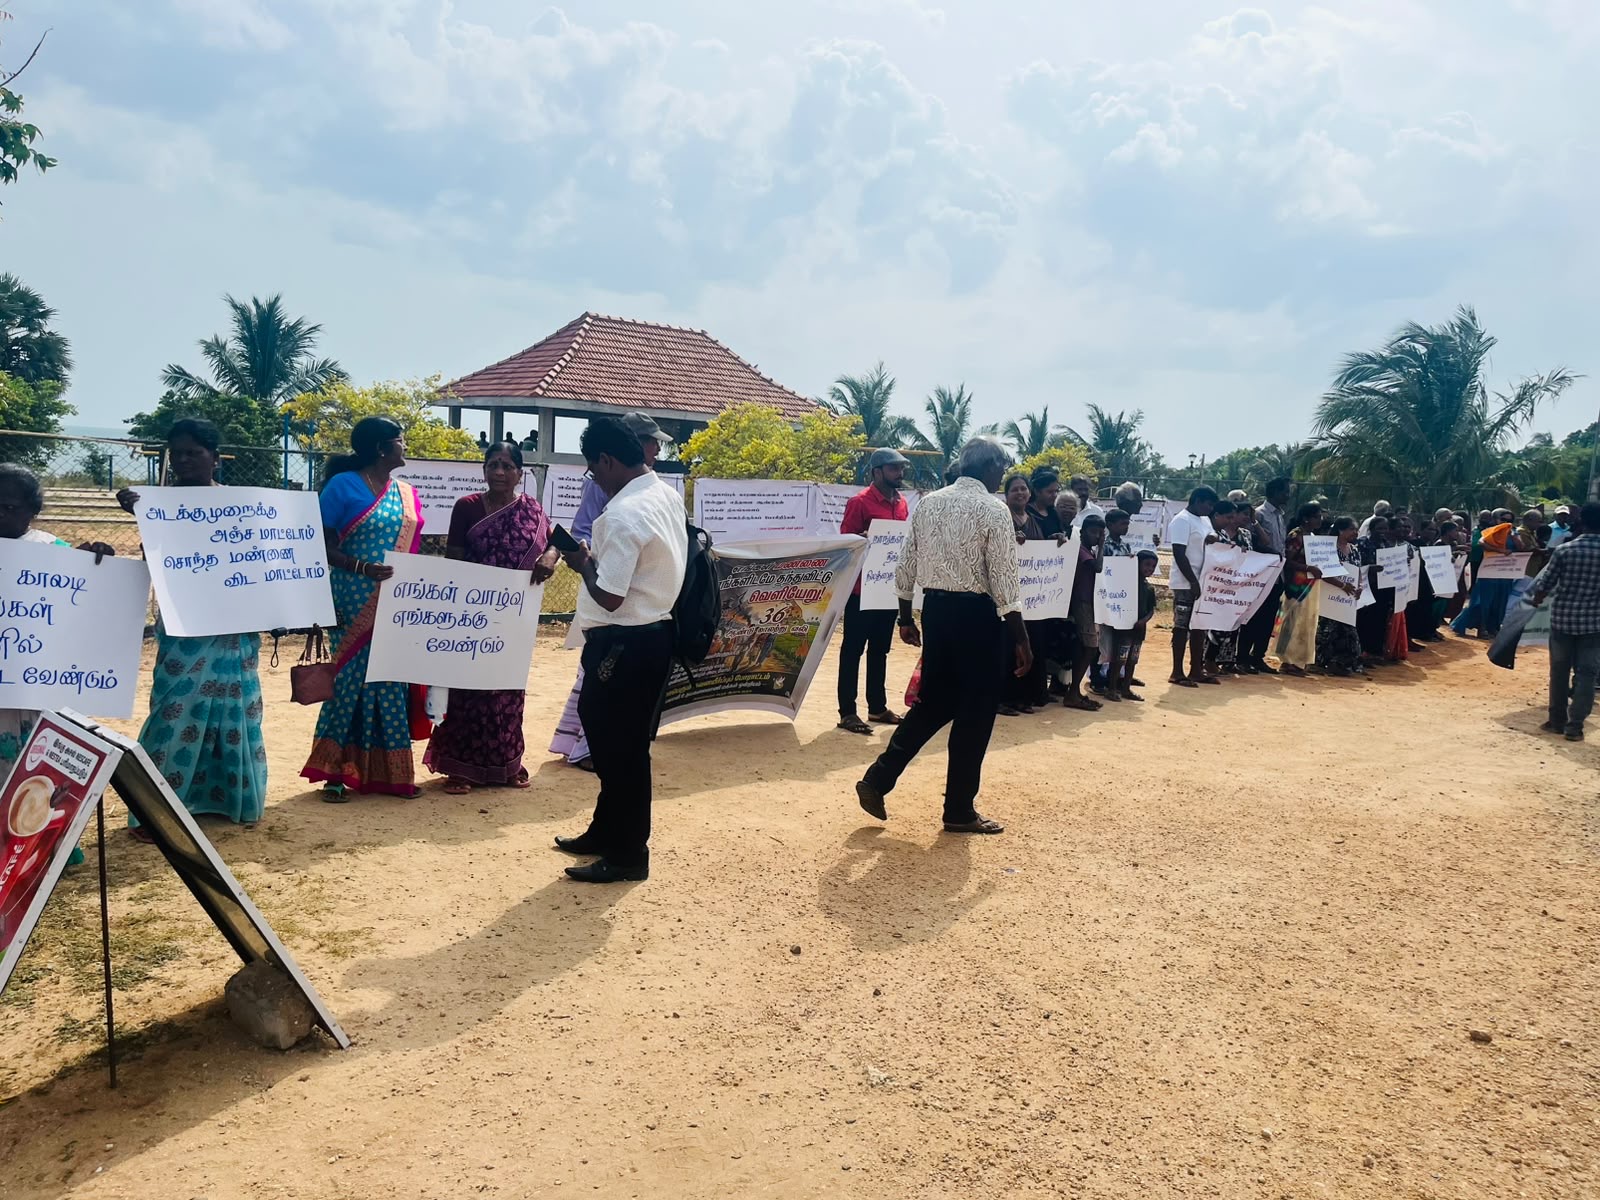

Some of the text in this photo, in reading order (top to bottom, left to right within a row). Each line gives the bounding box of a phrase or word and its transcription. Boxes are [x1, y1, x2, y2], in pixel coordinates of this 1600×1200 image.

[145, 501, 277, 523] அடக்குமுறைக்கு
[210, 524, 315, 544] அஞ்ச மாட்டோம்
[163, 551, 219, 574] சொந்த
[224, 561, 325, 588] விட மாட்டோம்
[776, 568, 833, 585] தந்துவிட்டு
[17, 569, 88, 606] காலடி
[393, 577, 525, 617] எங்கள் வாழ்வு
[749, 585, 827, 606] வெளியேறு!
[392, 607, 488, 631] எங்களுக்கு
[759, 605, 787, 625] 36
[426, 635, 505, 661] வேண்டும்
[23, 664, 118, 695] வேண்டும்
